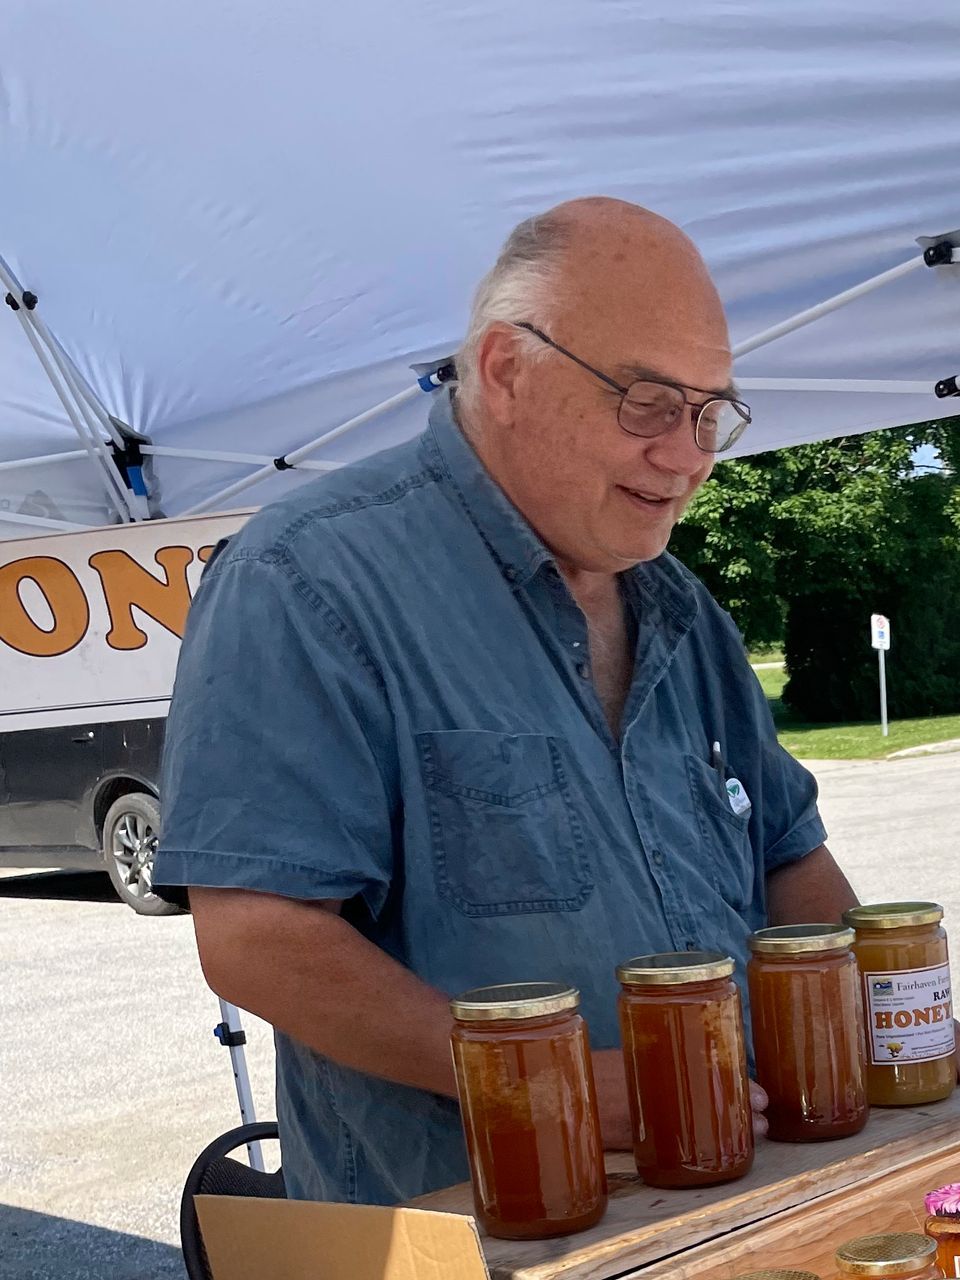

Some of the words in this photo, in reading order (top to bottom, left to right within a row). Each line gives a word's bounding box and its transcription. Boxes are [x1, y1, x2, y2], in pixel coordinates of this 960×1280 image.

[0, 545, 217, 657] ON
[896, 978, 937, 992] Fairhaven
[874, 1001, 952, 1029] HONEY
